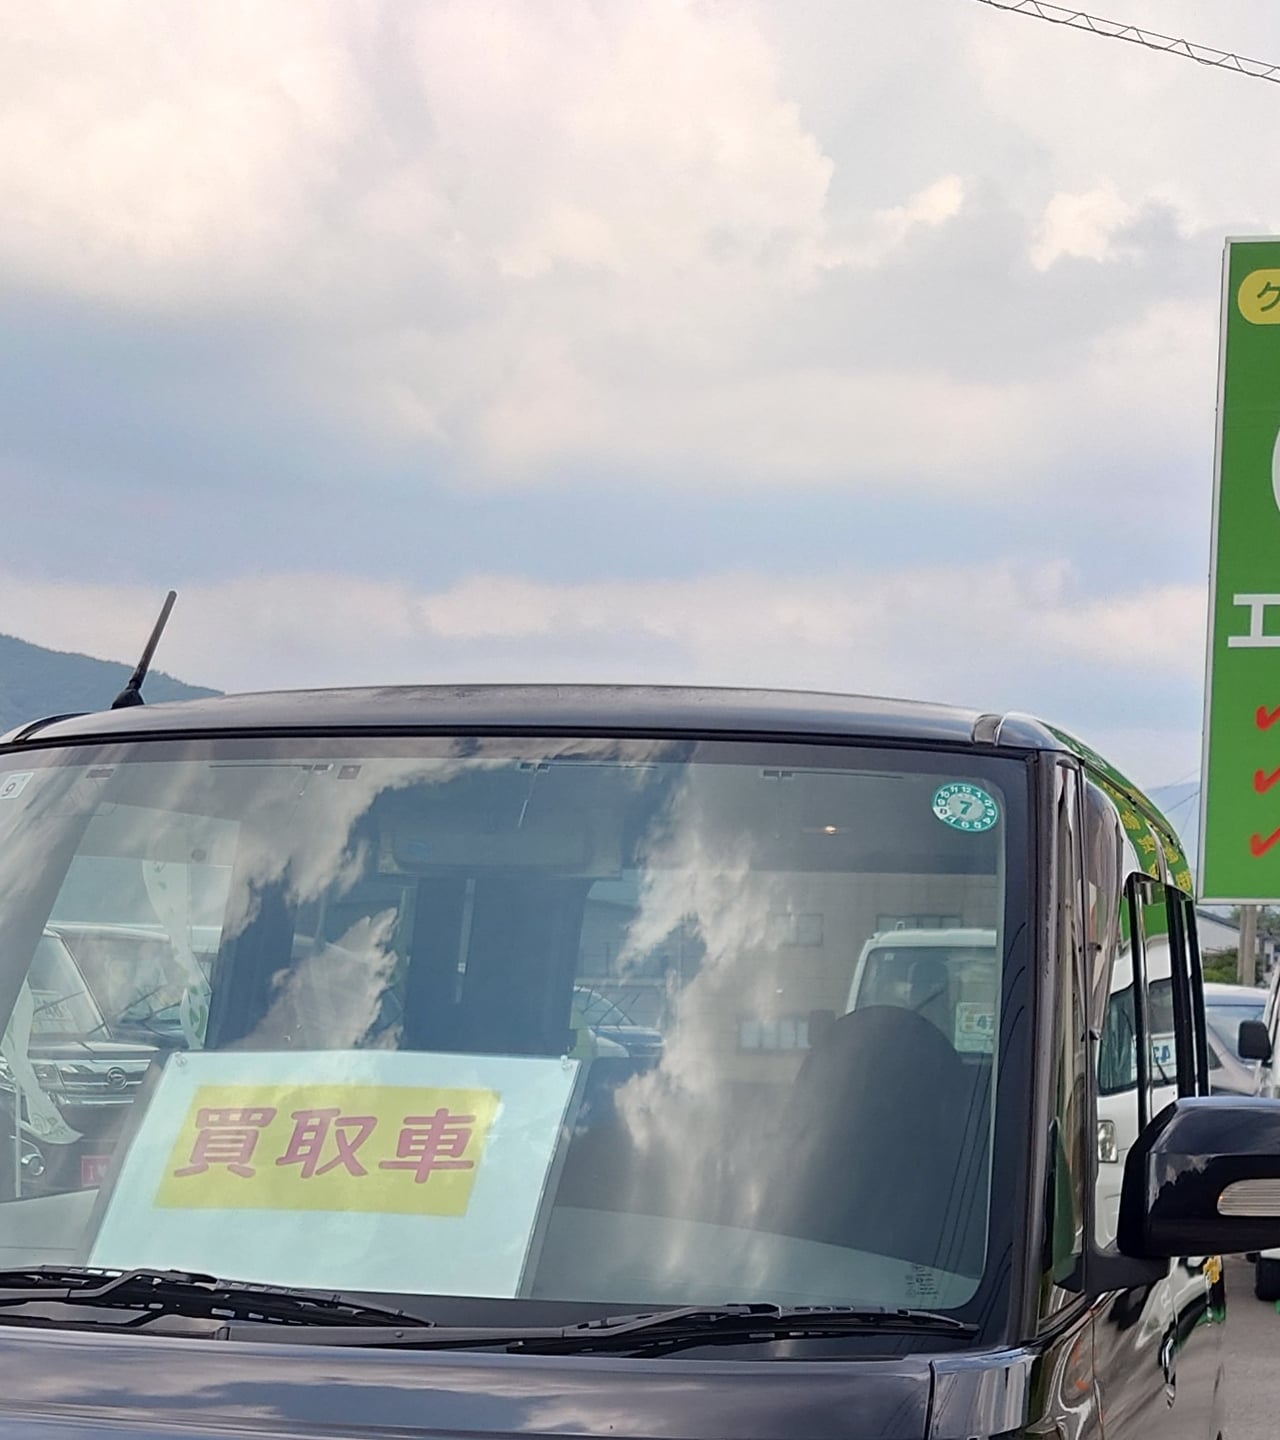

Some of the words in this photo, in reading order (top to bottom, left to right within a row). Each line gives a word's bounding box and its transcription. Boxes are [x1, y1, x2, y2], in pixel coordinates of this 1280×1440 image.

[959, 800, 973, 815] 7
[173, 1107, 477, 1184] 買取車
